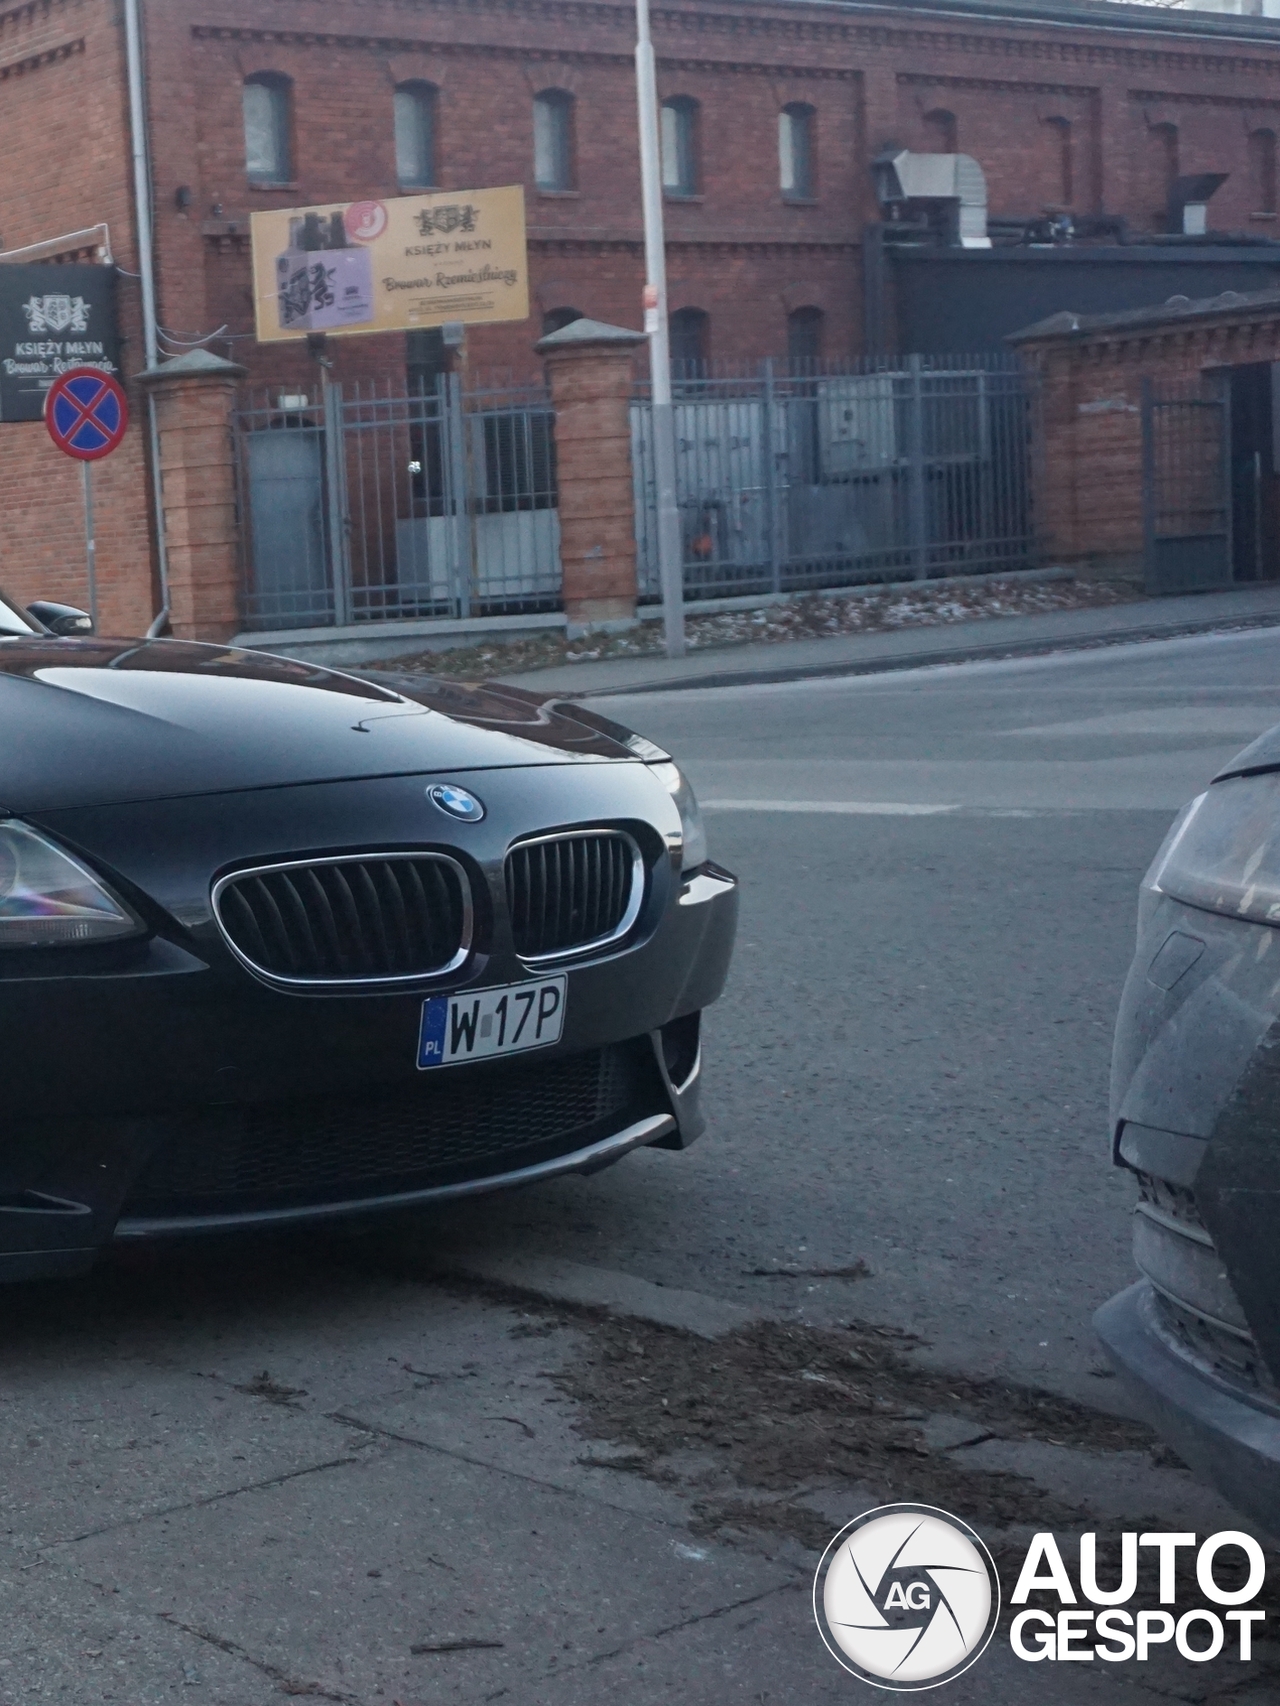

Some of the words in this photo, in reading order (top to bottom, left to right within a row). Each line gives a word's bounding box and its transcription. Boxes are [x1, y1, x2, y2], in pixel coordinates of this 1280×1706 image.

[405, 242, 450, 256] KSIĘŻY
[455, 240, 492, 252] MŁYN
[16, 339, 62, 357] KSIĘŻY
[66, 341, 103, 354] MŁYN
[425, 1041, 441, 1055] PL
